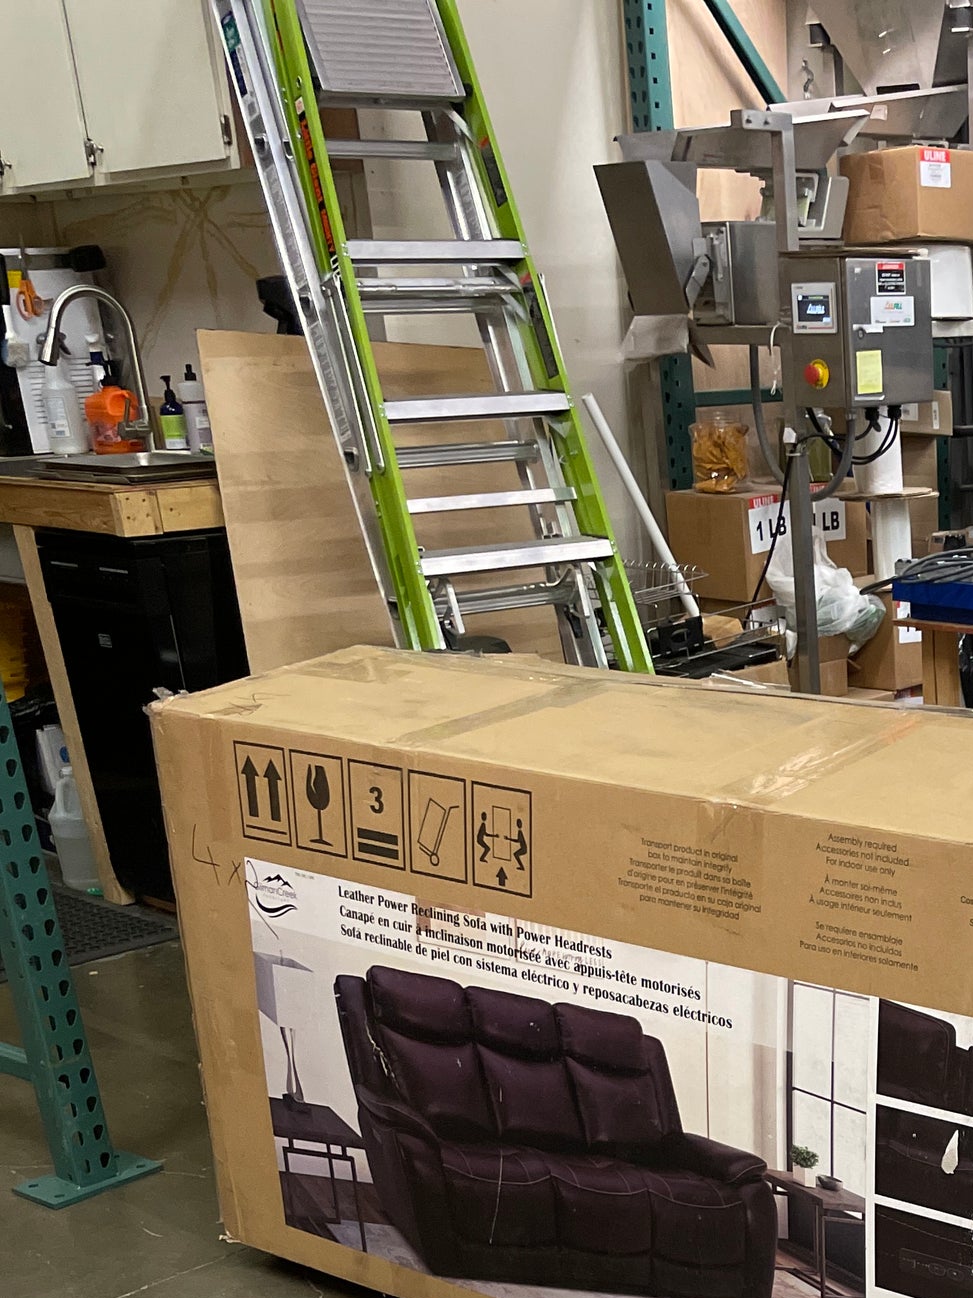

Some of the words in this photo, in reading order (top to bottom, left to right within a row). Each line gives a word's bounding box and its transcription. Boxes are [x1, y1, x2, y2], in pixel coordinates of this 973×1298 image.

[923, 150, 947, 162] ULINE
[756, 521, 764, 541] 1
[769, 515, 787, 538] LB
[822, 511, 840, 531] LB
[369, 786, 384, 814] 3
[640, 837, 672, 850] Transport
[673, 844, 702, 856] product
[703, 848, 710, 857] in
[711, 851, 738, 862] original
[827, 832, 863, 848] Assembly
[863, 840, 897, 852] required
[338, 885, 374, 904] Leather
[377, 894, 408, 912] Power
[411, 902, 464, 927] Reclining
[463, 911, 486, 930] Sofa
[489, 921, 512, 936] with
[514, 926, 551, 944] Power
[554, 934, 612, 959] Headrests
[339, 904, 374, 924] Canapé
[377, 916, 389, 927] en
[392, 920, 412, 932] cuir
[415, 923, 421, 935] à
[424, 925, 482, 949] inclinaison
[486, 942, 545, 963] motorisée
[544, 949, 569, 969] avec
[573, 956, 636, 985] appuis-tête
[641, 977, 700, 1000] motorisés
[340, 923, 361, 939] Sofá
[364, 932, 412, 952] reclinable
[415, 943, 427, 956] de
[430, 947, 449, 961] piel
[453, 954, 472, 966] con
[475, 958, 517, 977] sistema
[521, 968, 569, 989] eléctrico
[572, 982, 577, 994] y
[582, 984, 668, 1013] reposacabezas
[672, 1004, 732, 1028] eléctricos
